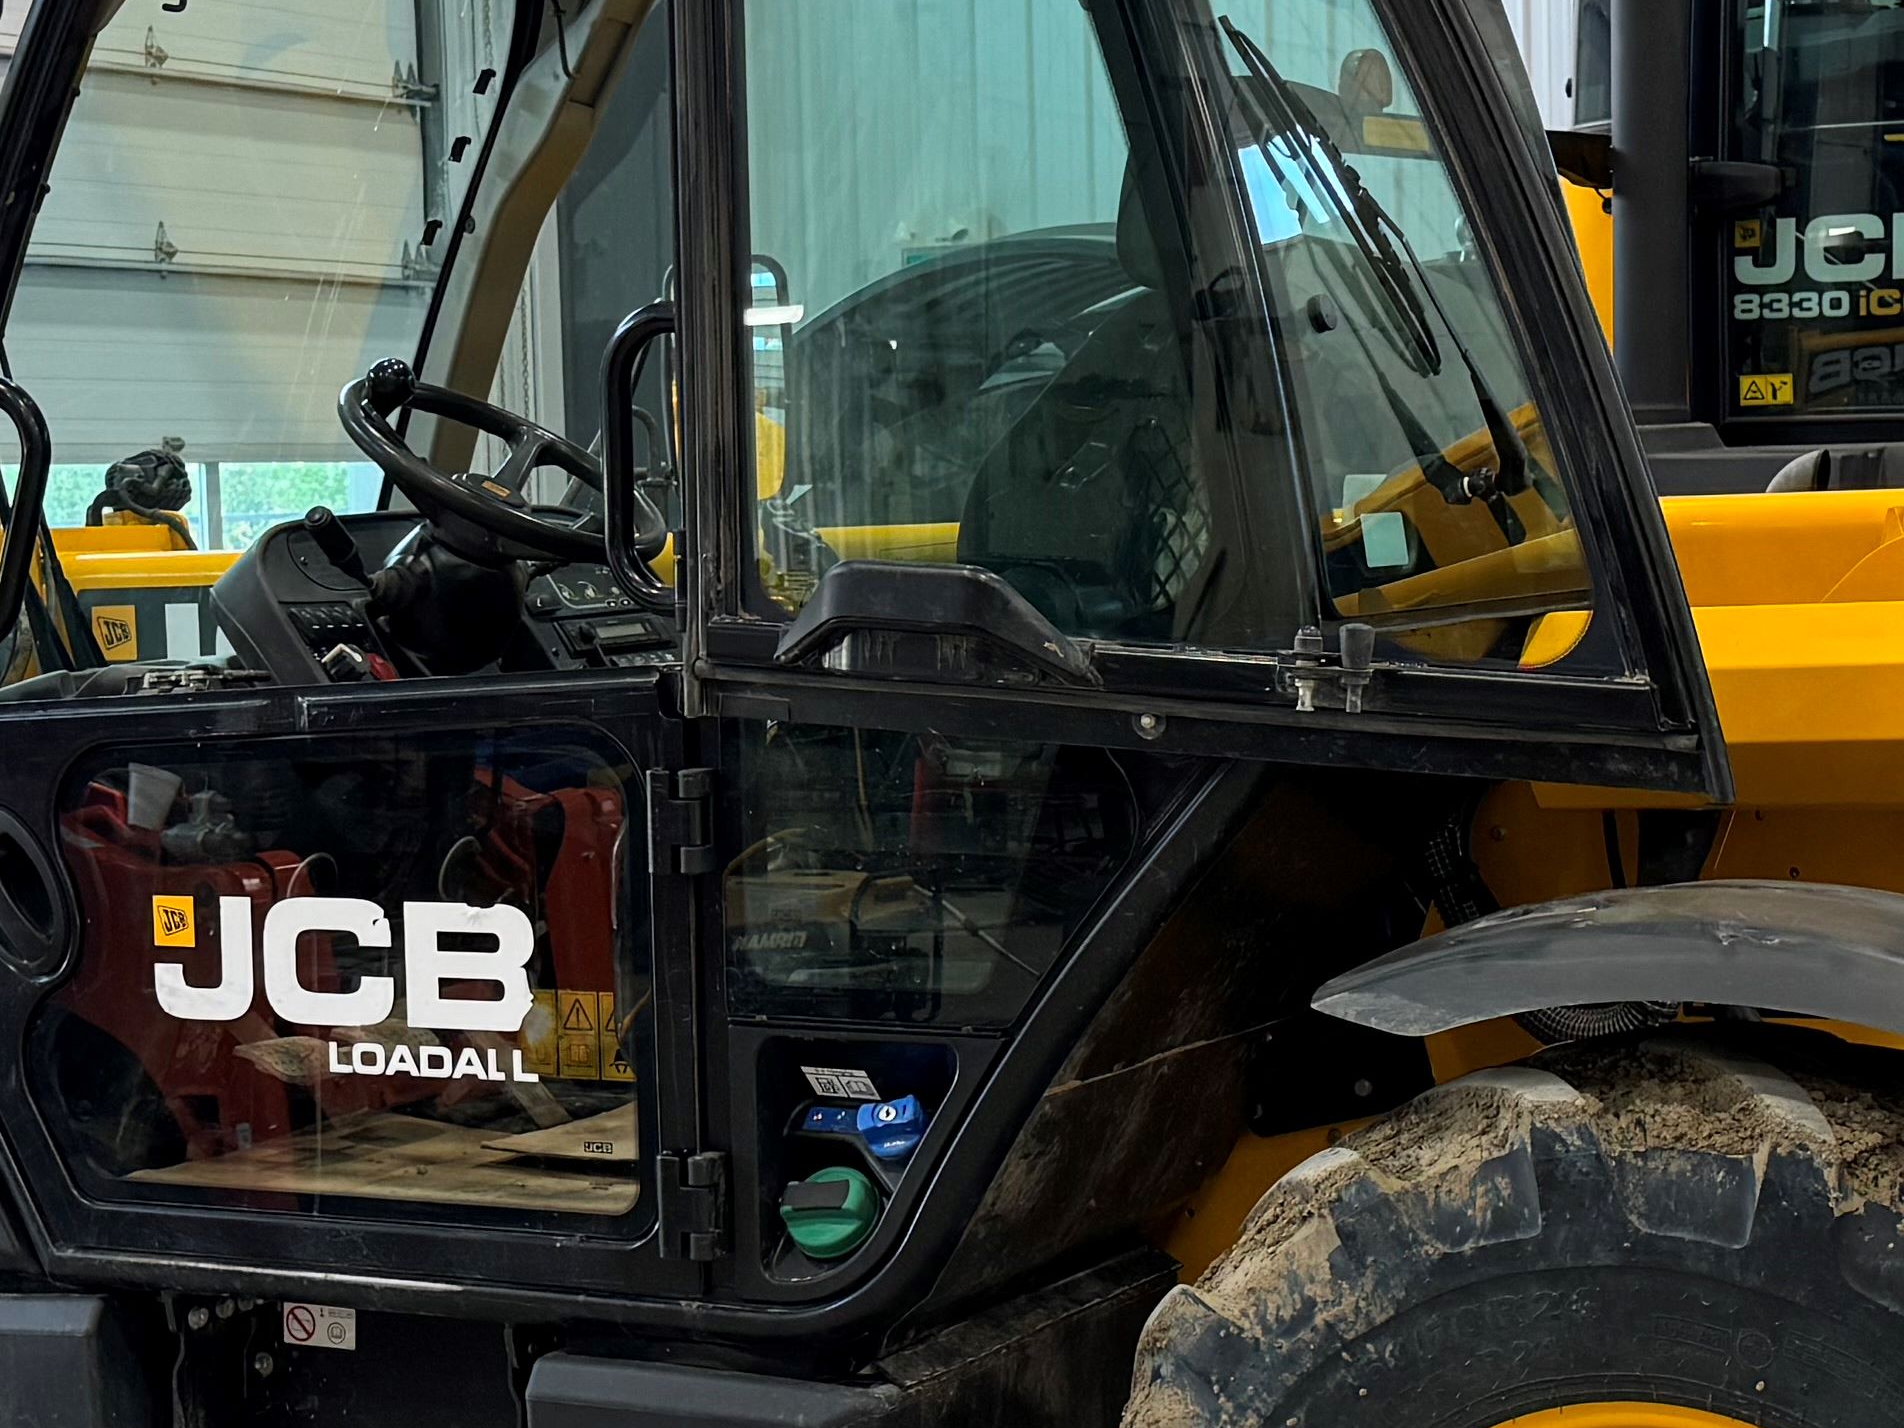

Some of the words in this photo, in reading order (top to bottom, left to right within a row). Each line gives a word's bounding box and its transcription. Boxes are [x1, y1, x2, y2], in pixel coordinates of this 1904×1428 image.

[1734, 290, 1850, 320] 8330
[104, 620, 130, 646] JCB
[153, 896, 535, 1032] JCB
[329, 1041, 539, 1083] LOADALL
[584, 1142, 613, 1154] JCB
